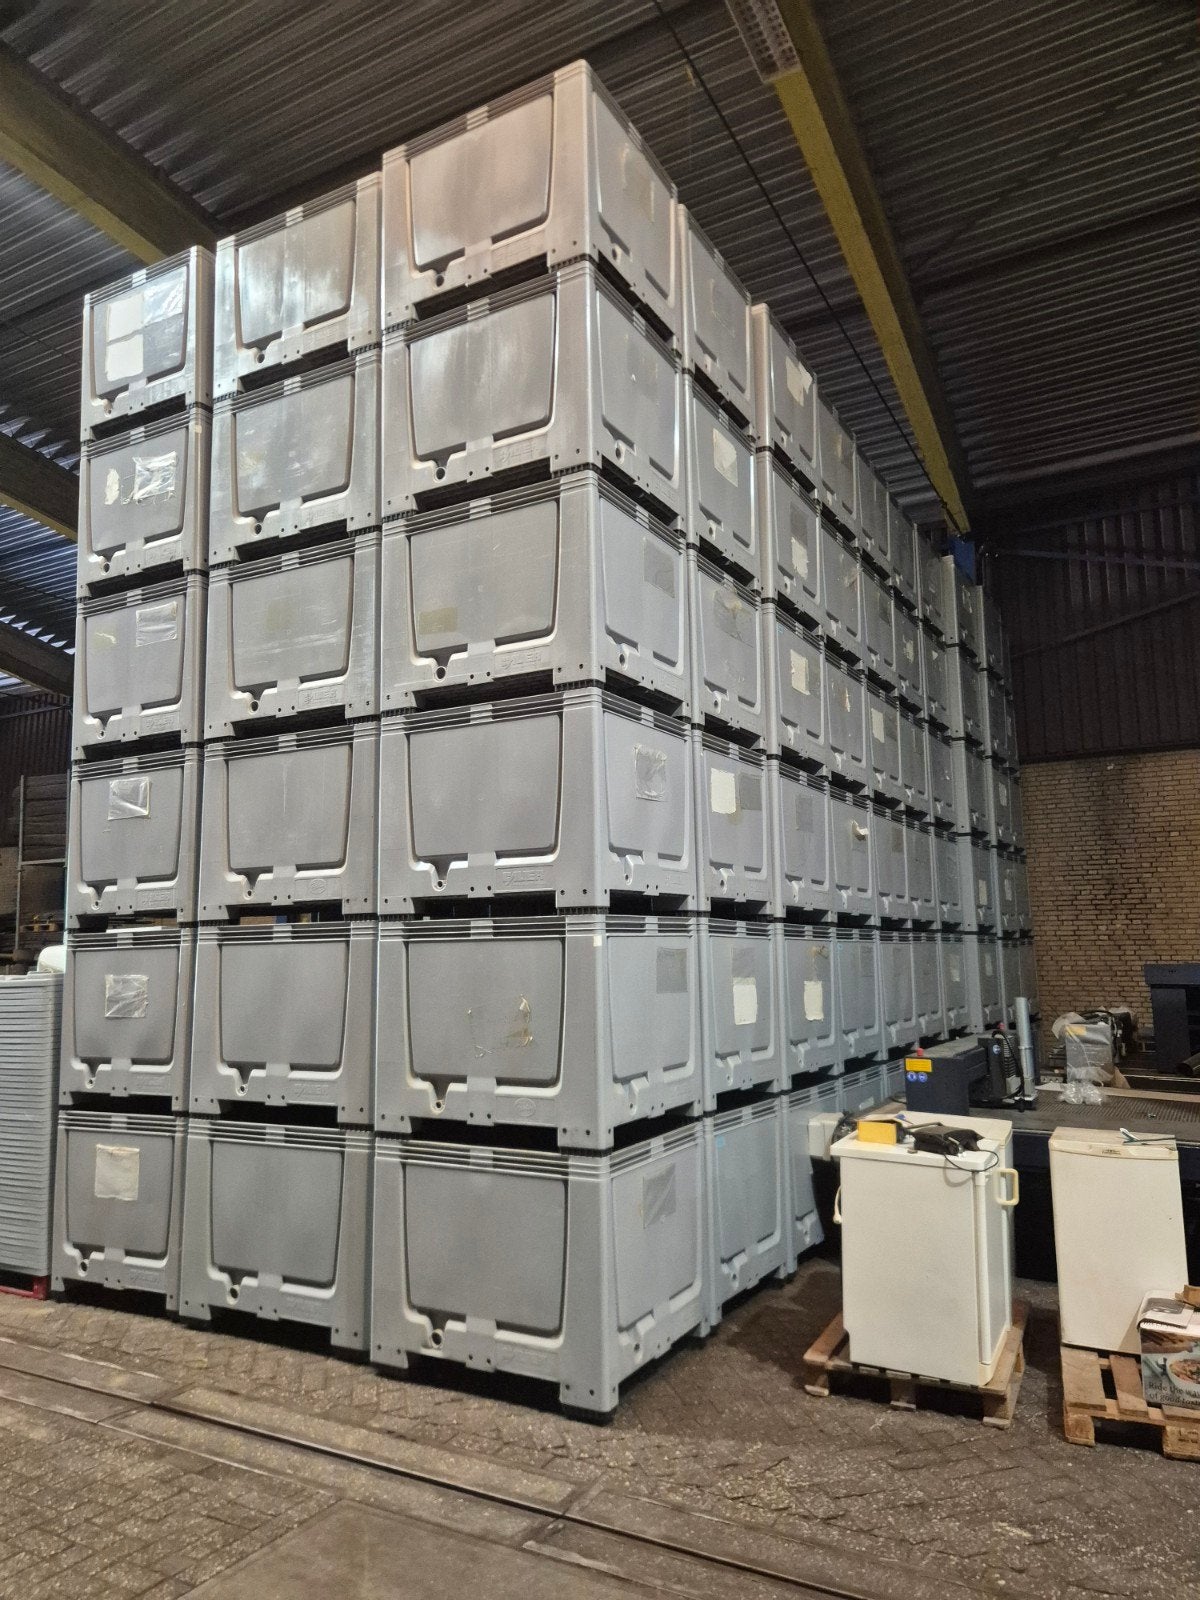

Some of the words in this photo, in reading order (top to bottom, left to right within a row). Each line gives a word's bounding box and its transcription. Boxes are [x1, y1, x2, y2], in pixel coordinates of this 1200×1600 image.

[1149, 1381, 1167, 1391] Ride
[1169, 1385, 1184, 1394] the
[1160, 1394, 1181, 1404] good
